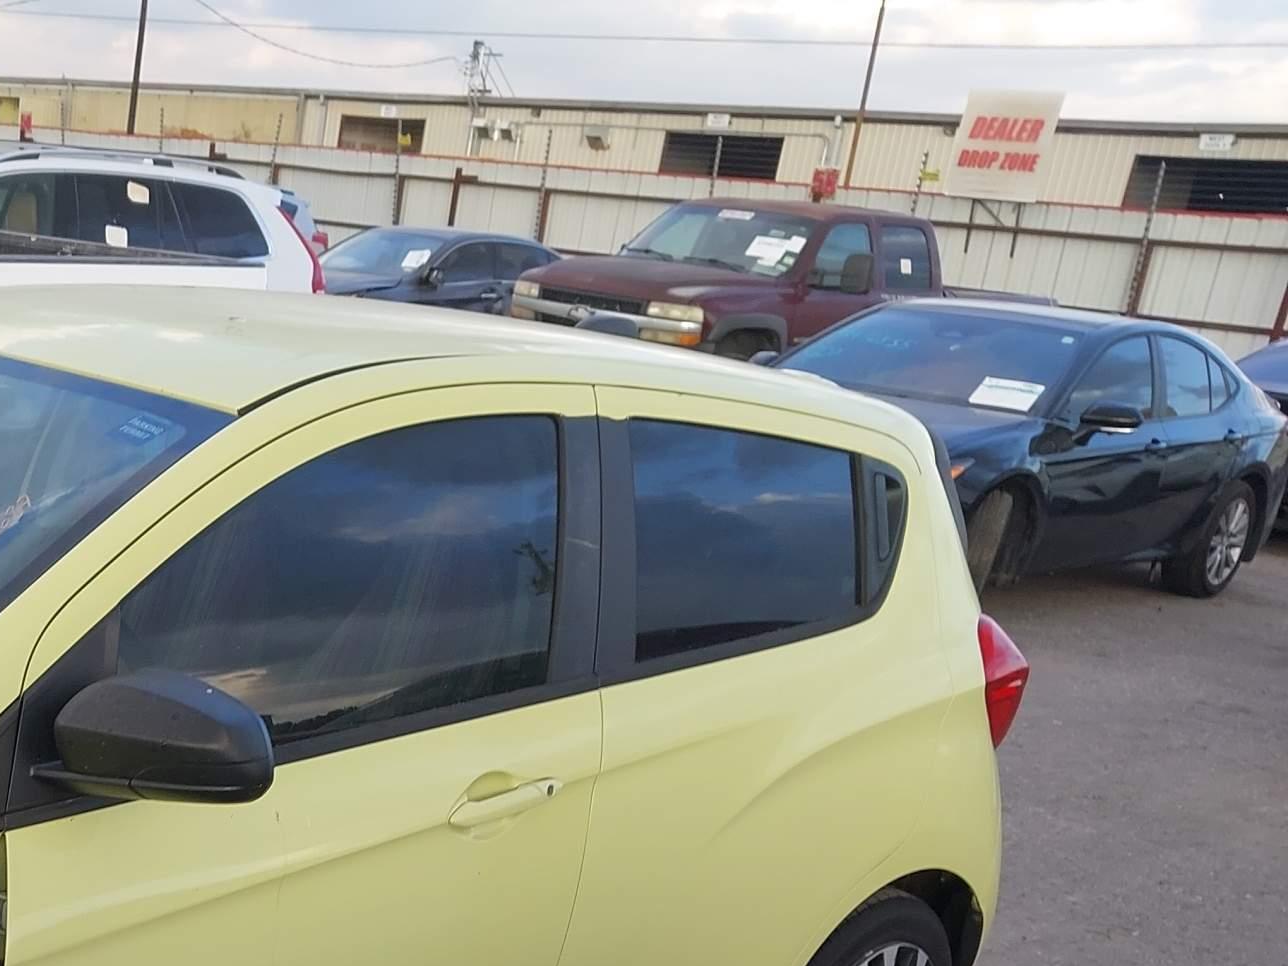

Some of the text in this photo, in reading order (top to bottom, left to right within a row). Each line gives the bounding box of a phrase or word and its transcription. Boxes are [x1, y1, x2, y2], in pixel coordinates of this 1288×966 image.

[968, 116, 1046, 143] DEALER
[957, 149, 1040, 173] DROP ZONE
